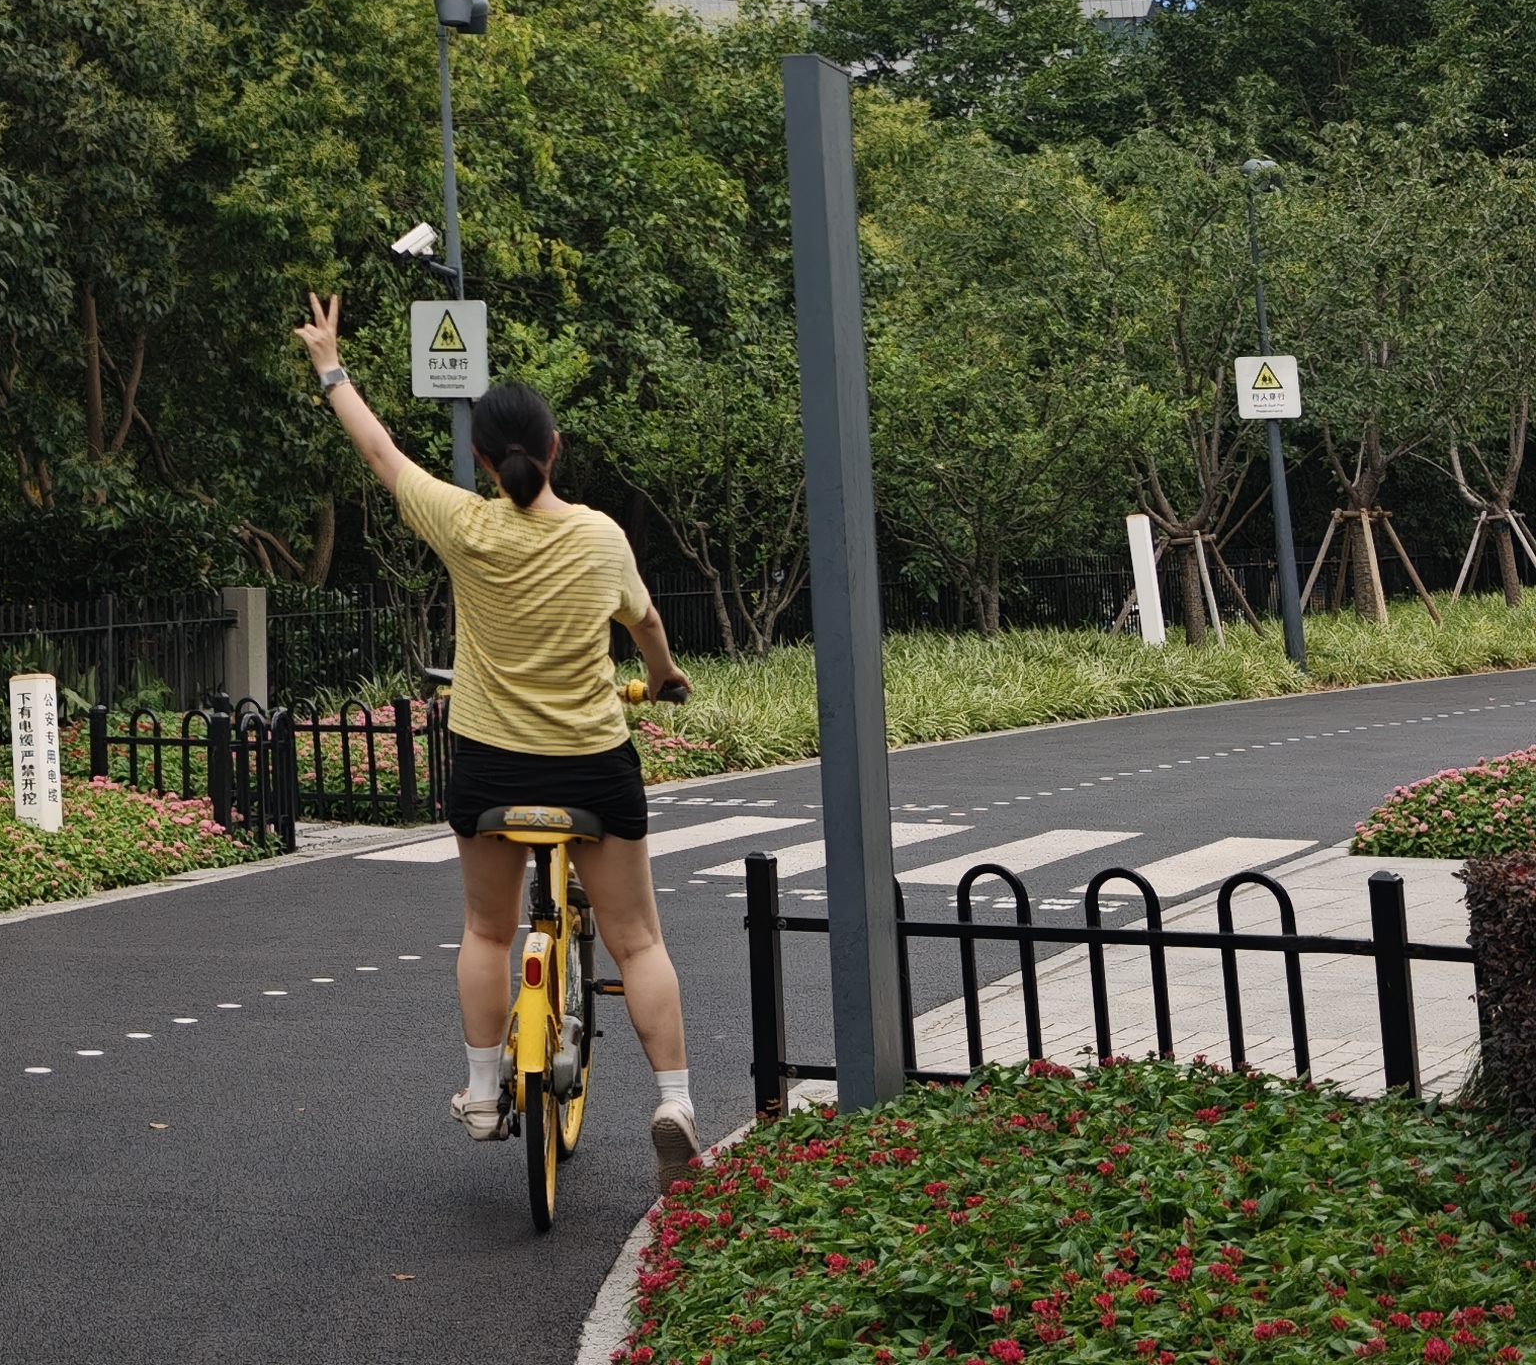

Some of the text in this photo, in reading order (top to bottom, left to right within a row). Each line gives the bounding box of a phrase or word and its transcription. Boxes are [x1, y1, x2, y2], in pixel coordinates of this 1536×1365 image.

[428, 357, 469, 370] 行人穿行
[16, 692, 37, 806] 下有电缆严禁开挖
